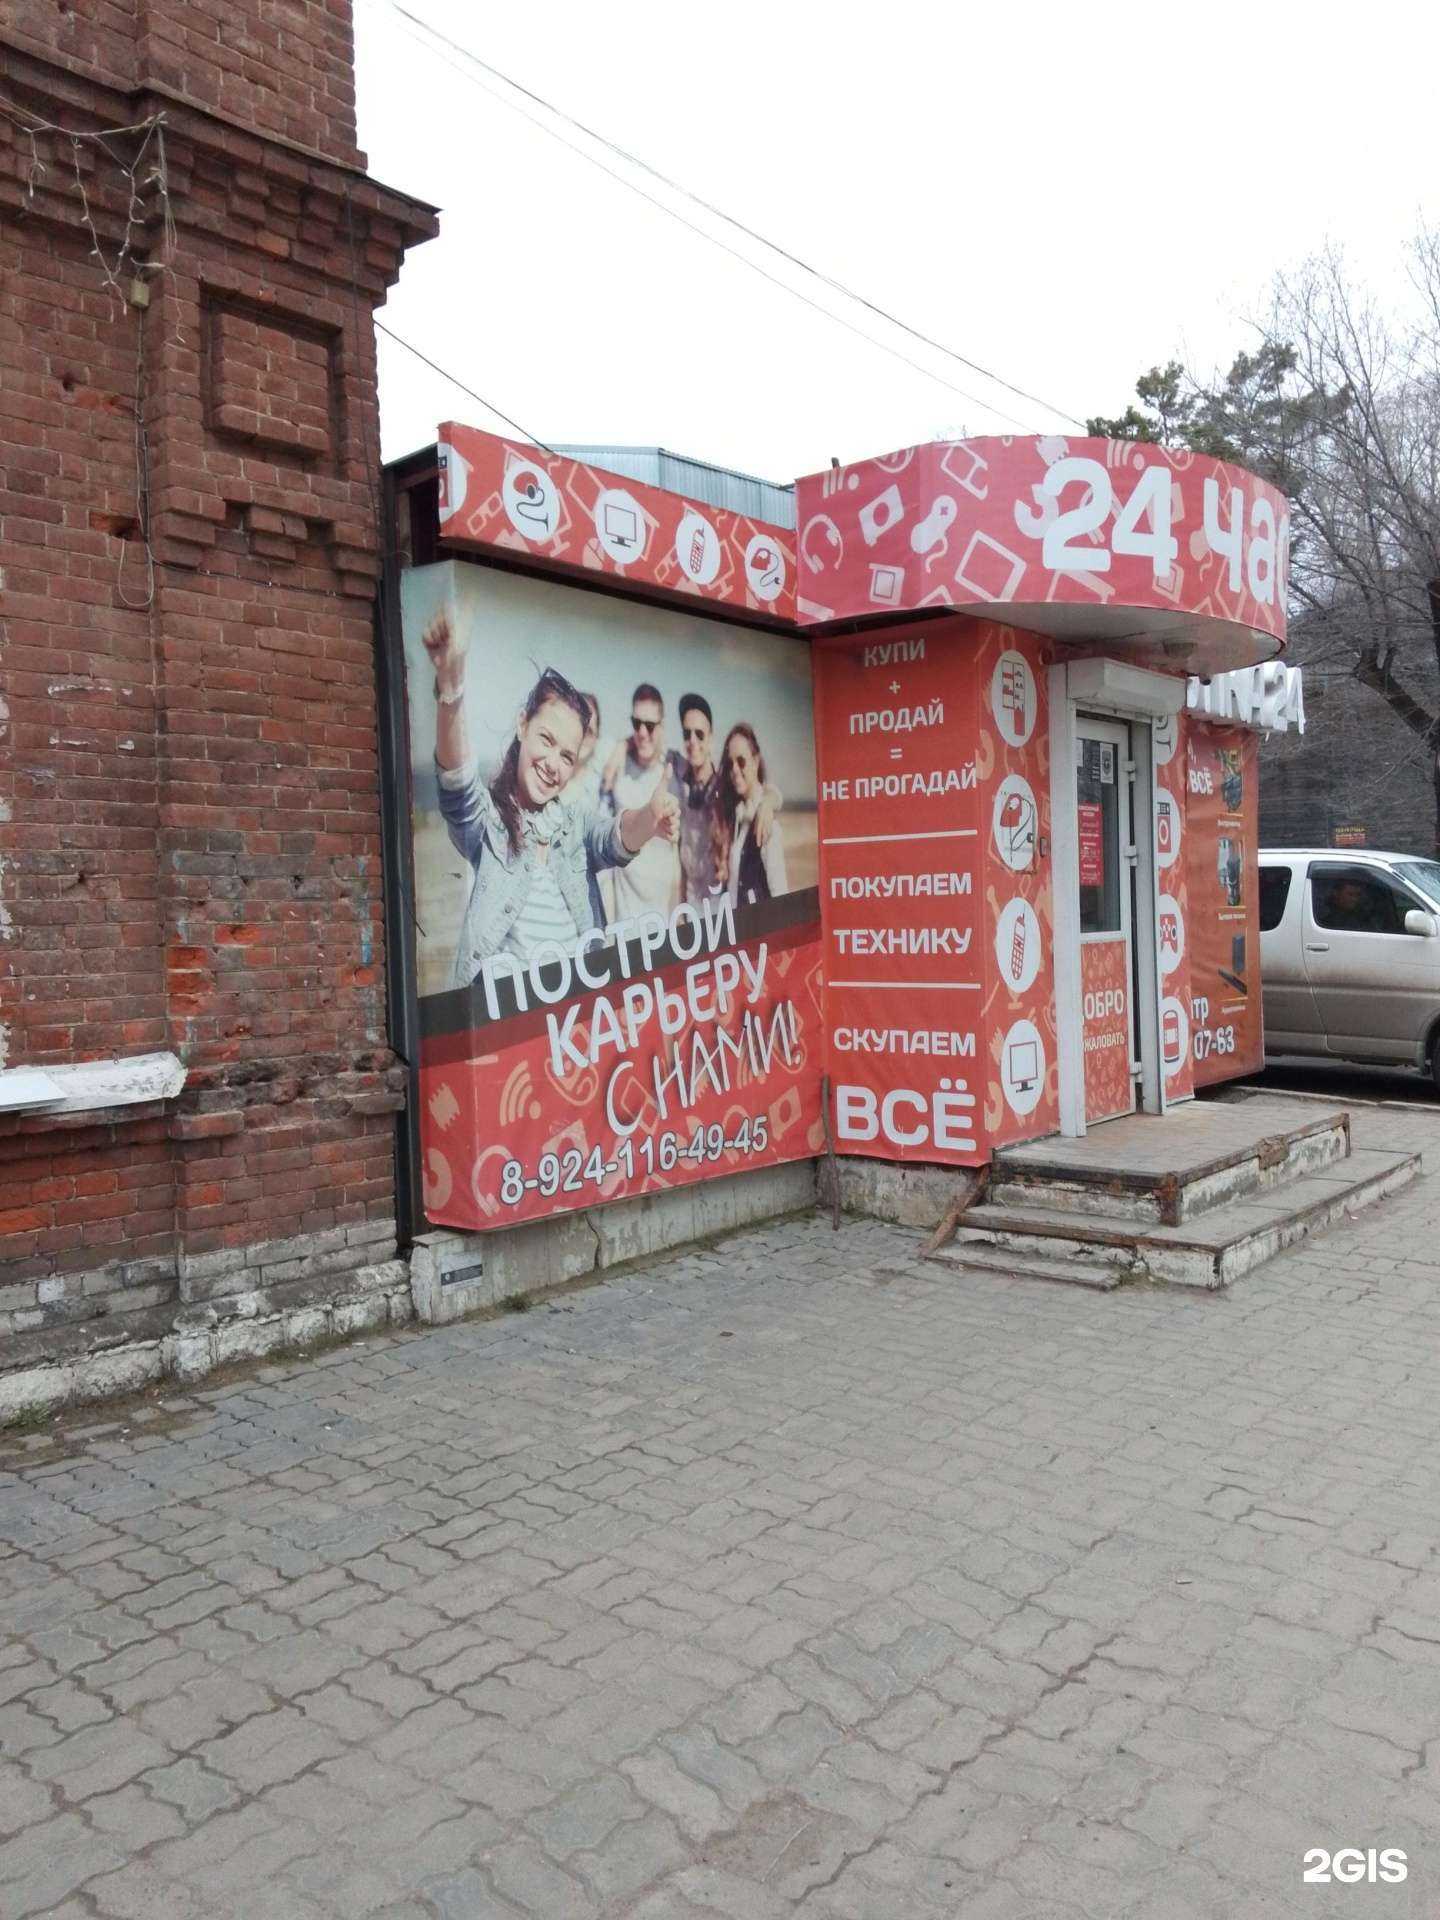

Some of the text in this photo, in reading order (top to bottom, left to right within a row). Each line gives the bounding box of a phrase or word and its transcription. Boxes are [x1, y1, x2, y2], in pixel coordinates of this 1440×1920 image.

[1043, 457, 1178, 579] 24
[864, 638, 925, 668] КУПИ
[849, 697, 944, 735] ПРОДАЙ
[822, 760, 978, 801] НЕ ПРОГАДАЙ
[1189, 766, 1214, 796] ВСЁ
[831, 872, 973, 900] ПОКУПАЕМ
[481, 882, 737, 1021] ПОСТРОЙ
[833, 927, 974, 956] ТЕХНИКУ
[546, 943, 769, 1078] КАРЬЕРУ
[1083, 989, 1125, 1020] ОБРО
[834, 1027, 977, 1058] СКУПАЕМ
[605, 1000, 802, 1137] С НАМИ!
[836, 1077, 977, 1153] ВСЁ
[500, 1116, 769, 1206] 8-924-116-49-45
